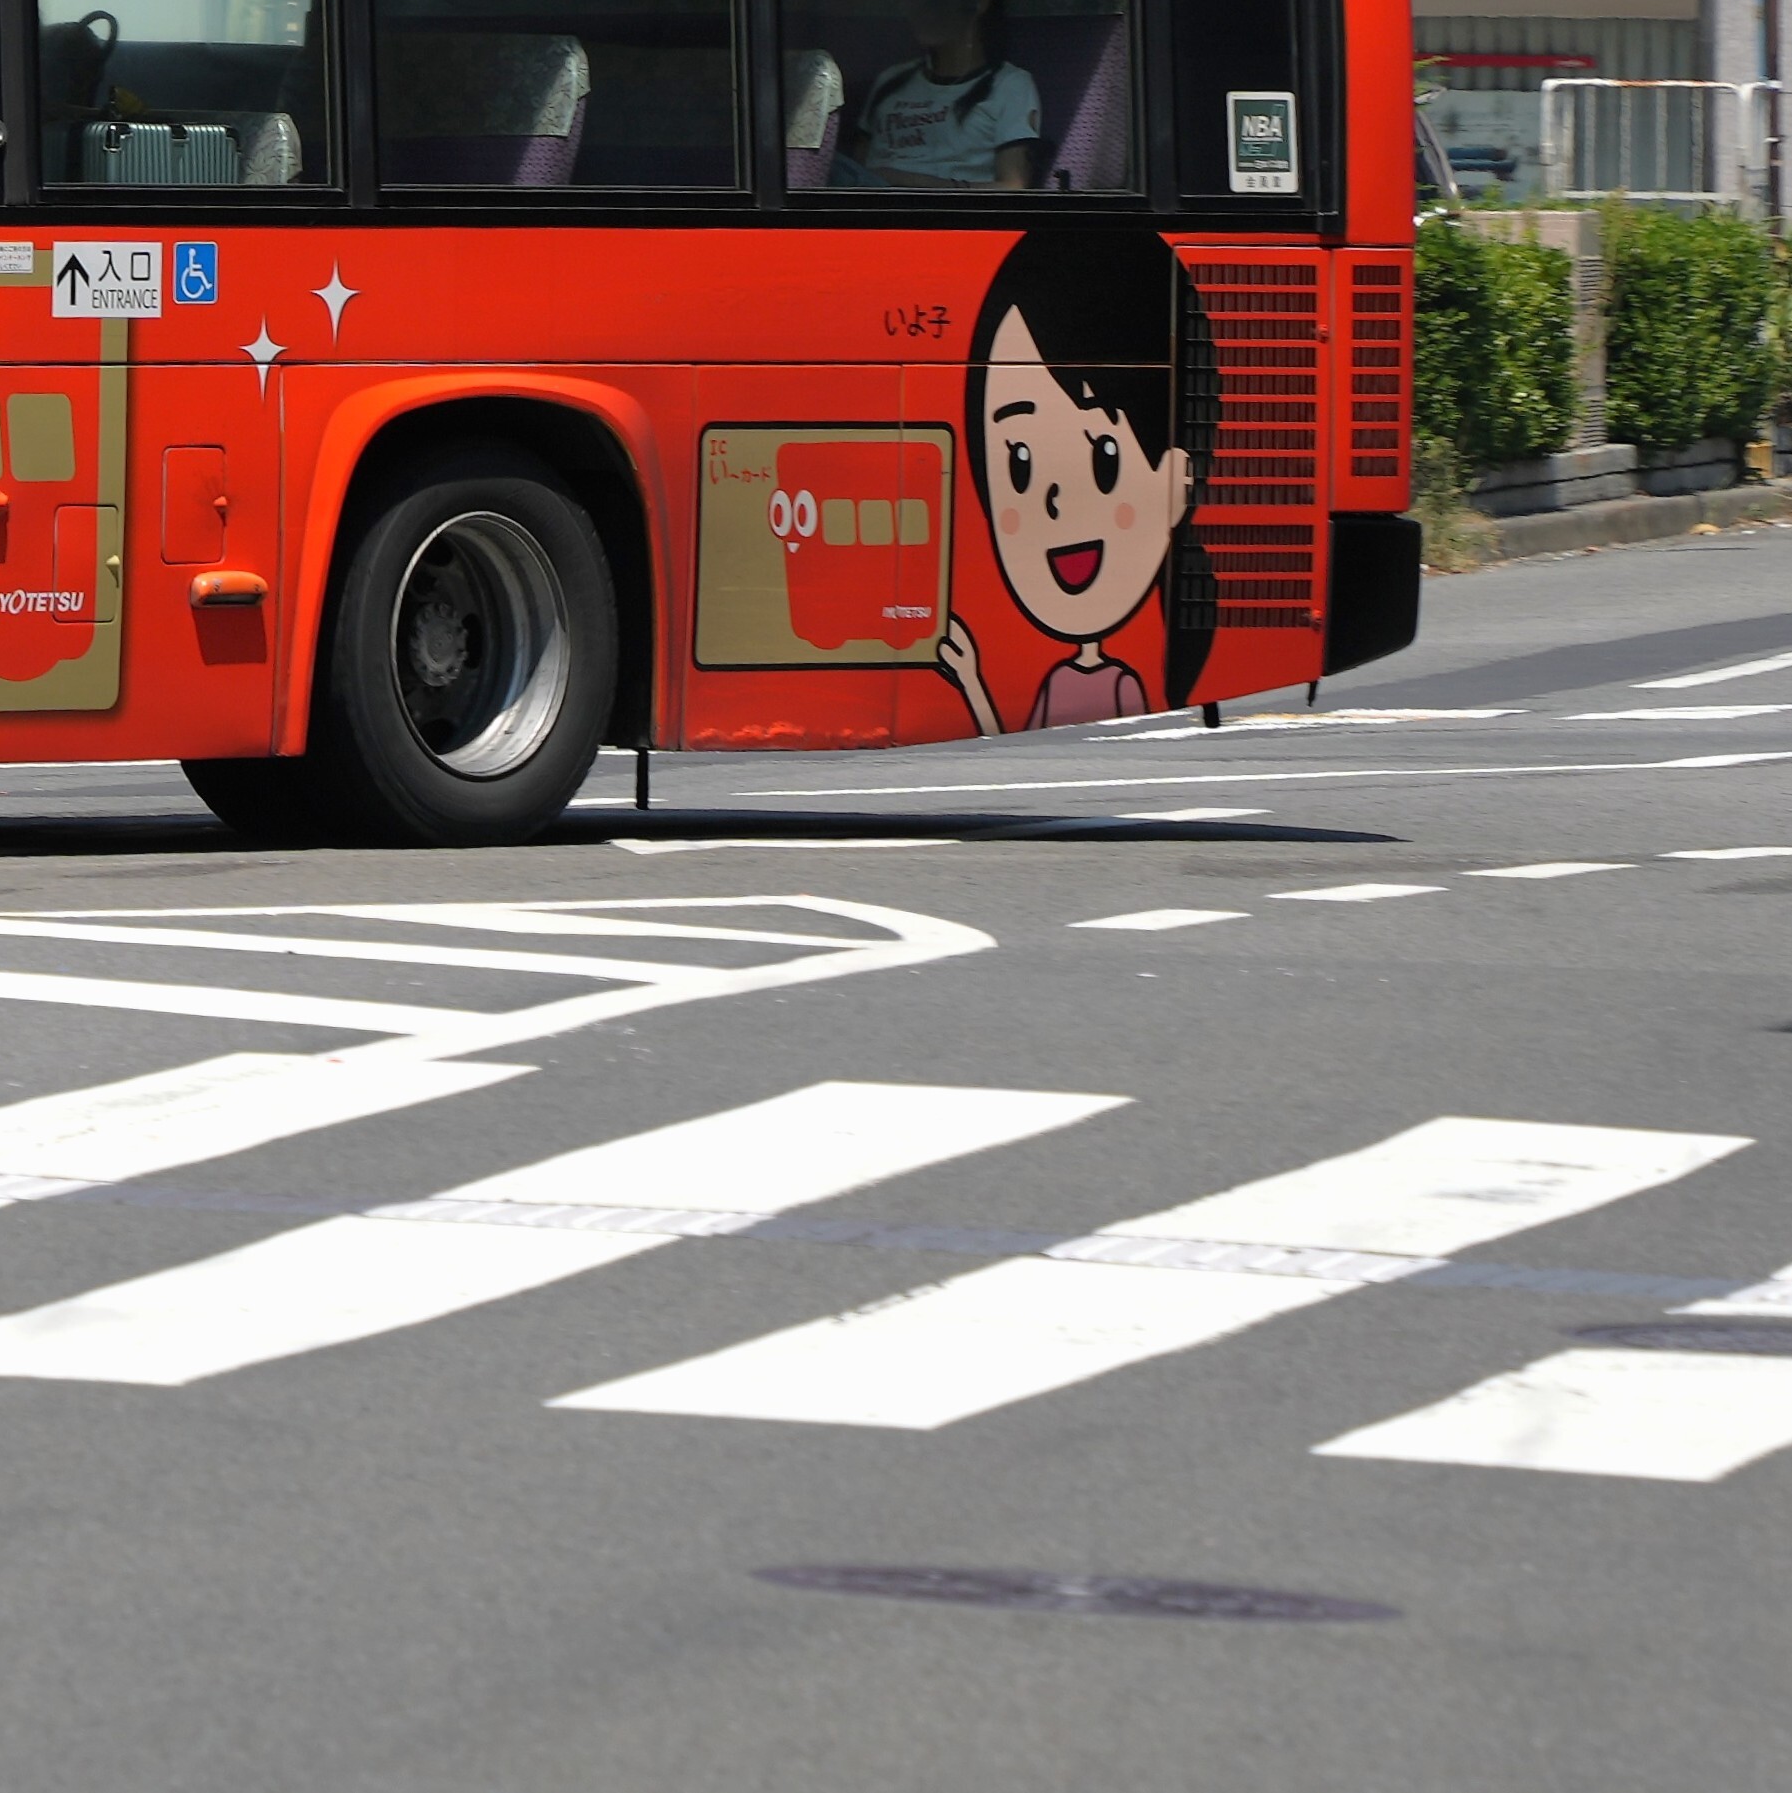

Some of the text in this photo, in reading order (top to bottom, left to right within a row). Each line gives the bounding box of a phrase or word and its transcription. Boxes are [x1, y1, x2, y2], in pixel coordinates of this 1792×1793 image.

[1241, 115, 1283, 138] NBA
[97, 250, 151, 282] 入口
[91, 288, 158, 310] ENTRANCE
[884, 306, 951, 339] いよ子
[710, 440, 726, 455] IC
[881, 605, 932, 619] IYOTETSU
